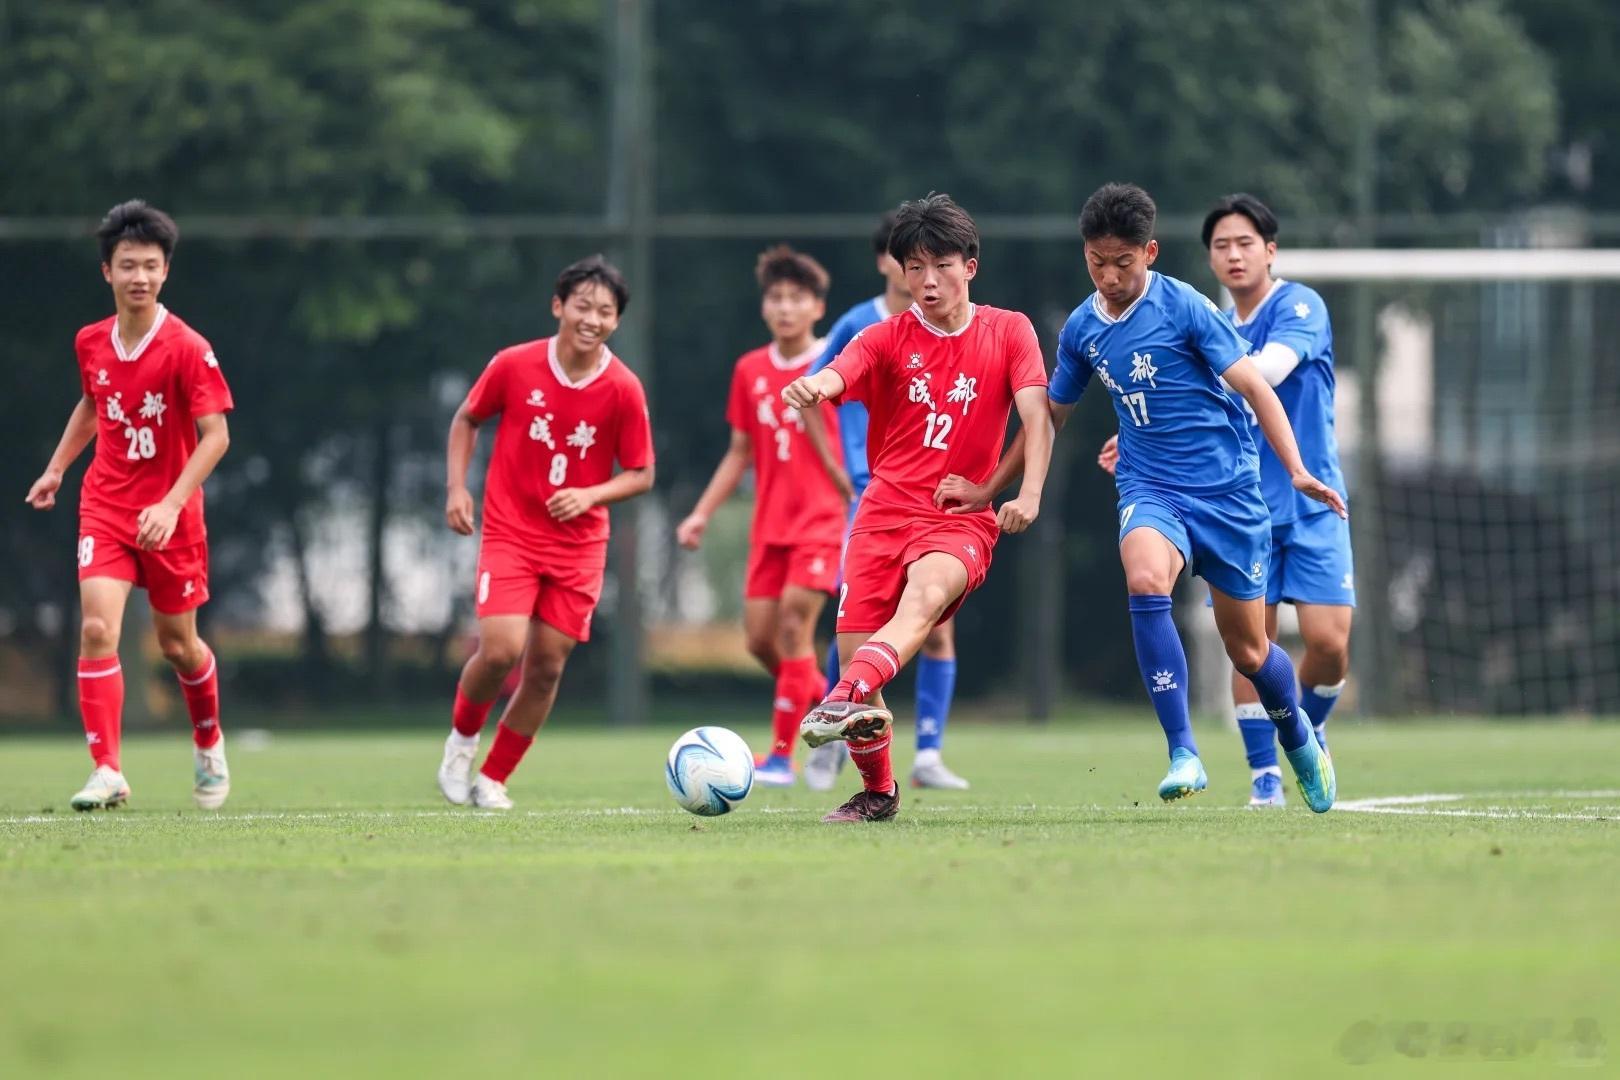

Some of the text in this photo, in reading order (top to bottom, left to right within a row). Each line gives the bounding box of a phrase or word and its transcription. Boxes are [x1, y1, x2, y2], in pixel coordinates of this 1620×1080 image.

[107, 391, 167, 427] 成都
[908, 372, 978, 416] 成都
[1121, 391, 1151, 427] 17
[124, 426, 157, 461] 28
[528, 412, 598, 460] 成都
[922, 412, 953, 451] 12
[548, 452, 569, 487] 8
[77, 535, 95, 568] 8
[837, 582, 849, 618] 2
[1152, 682, 1178, 693] KELME
